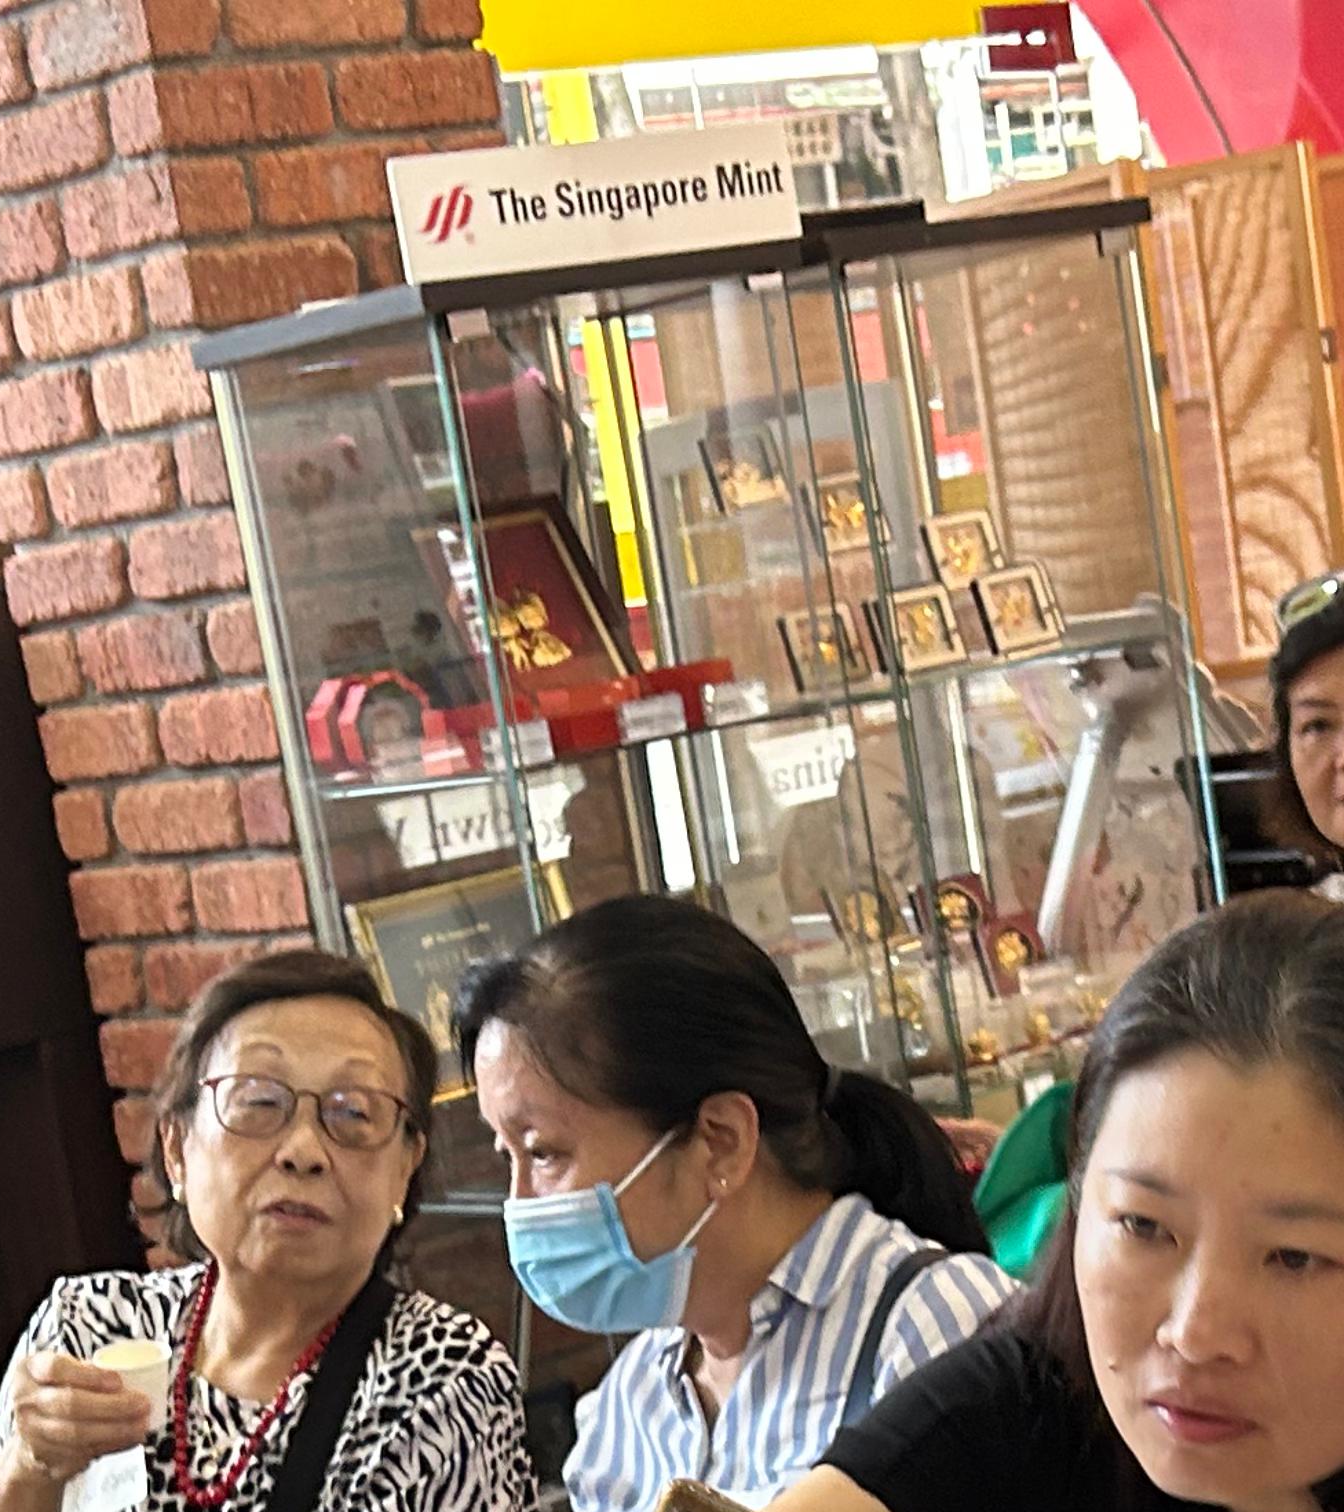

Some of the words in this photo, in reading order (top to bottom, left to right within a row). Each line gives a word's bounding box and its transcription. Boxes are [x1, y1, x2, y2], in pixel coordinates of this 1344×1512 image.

[489, 187, 547, 225] The
[557, 173, 709, 220] Singapore
[716, 159, 785, 201] Mint
